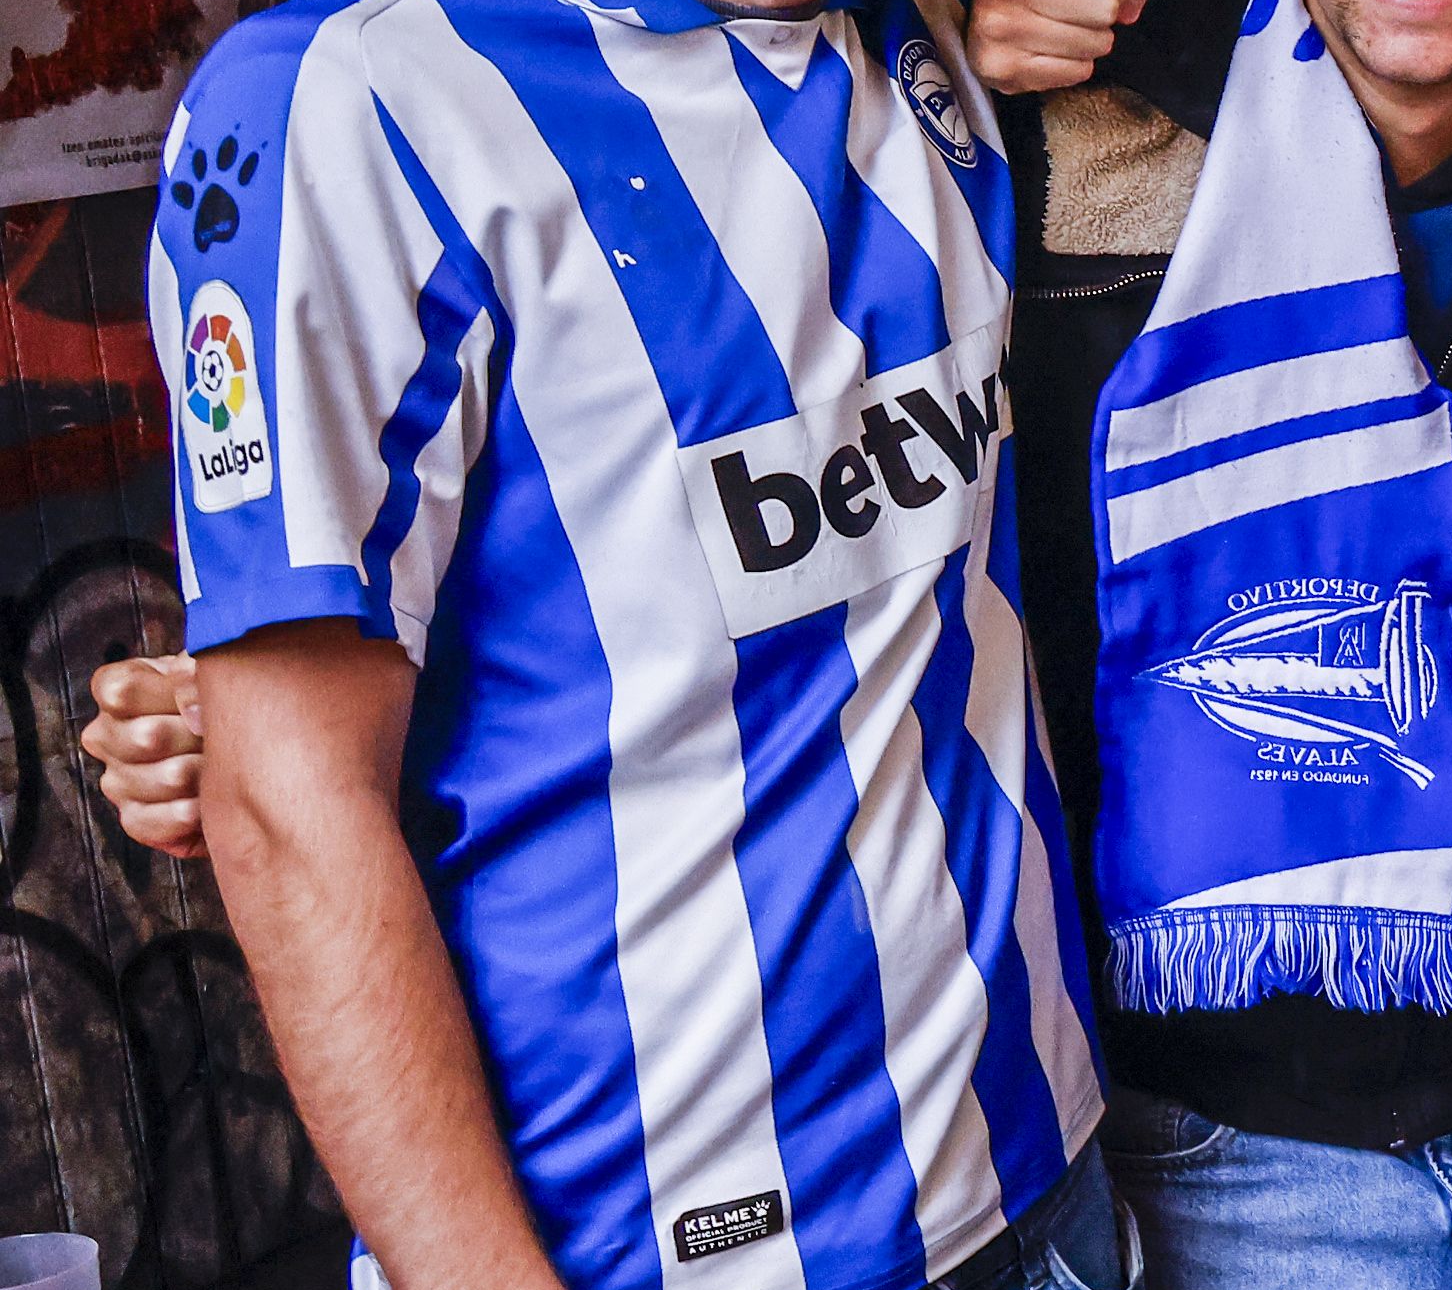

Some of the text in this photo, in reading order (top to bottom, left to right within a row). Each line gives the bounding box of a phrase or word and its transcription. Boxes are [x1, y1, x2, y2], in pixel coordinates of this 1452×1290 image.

[199, 437, 265, 481] LaLiga
[711, 359, 1010, 573] betw
[684, 1207, 752, 1234] KELME
[684, 1217, 768, 1243] OFFICIAL PRODUCT
[688, 1228, 768, 1256] AUTHENTIC
